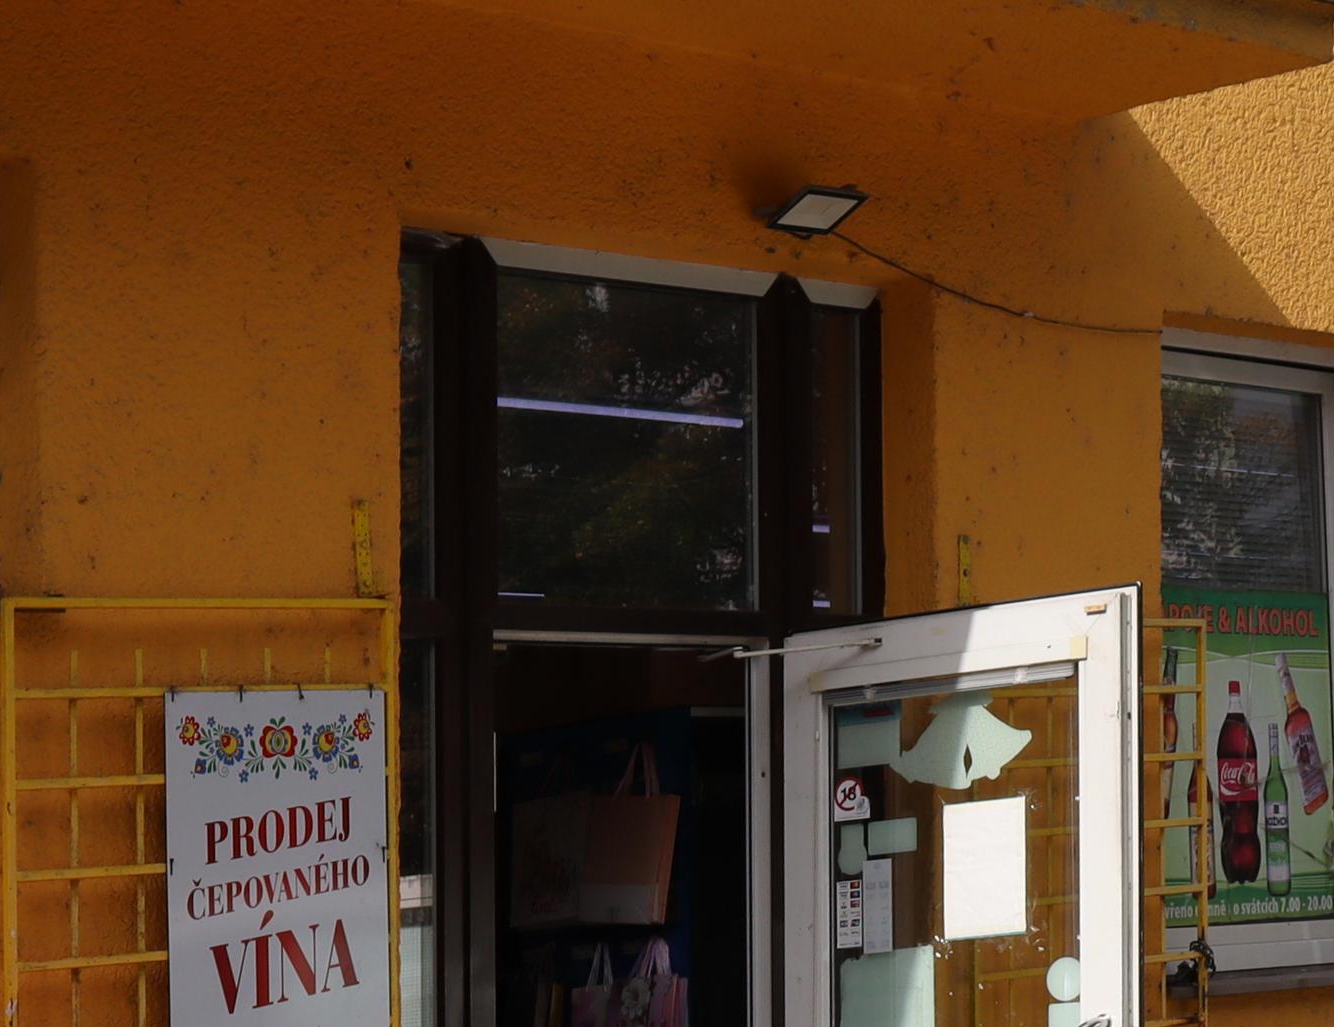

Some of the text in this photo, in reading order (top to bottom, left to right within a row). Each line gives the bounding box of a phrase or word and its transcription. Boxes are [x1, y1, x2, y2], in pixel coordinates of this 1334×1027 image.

[1163, 604, 1319, 637] POE & ALKOHOL
[204, 796, 352, 866] PRODEJ
[186, 853, 370, 921] ČEPOVANÉHO
[1280, 898, 1301, 913] 7.00
[1307, 894, 1333, 911] 20.00
[209, 909, 360, 1016] VÍNA
